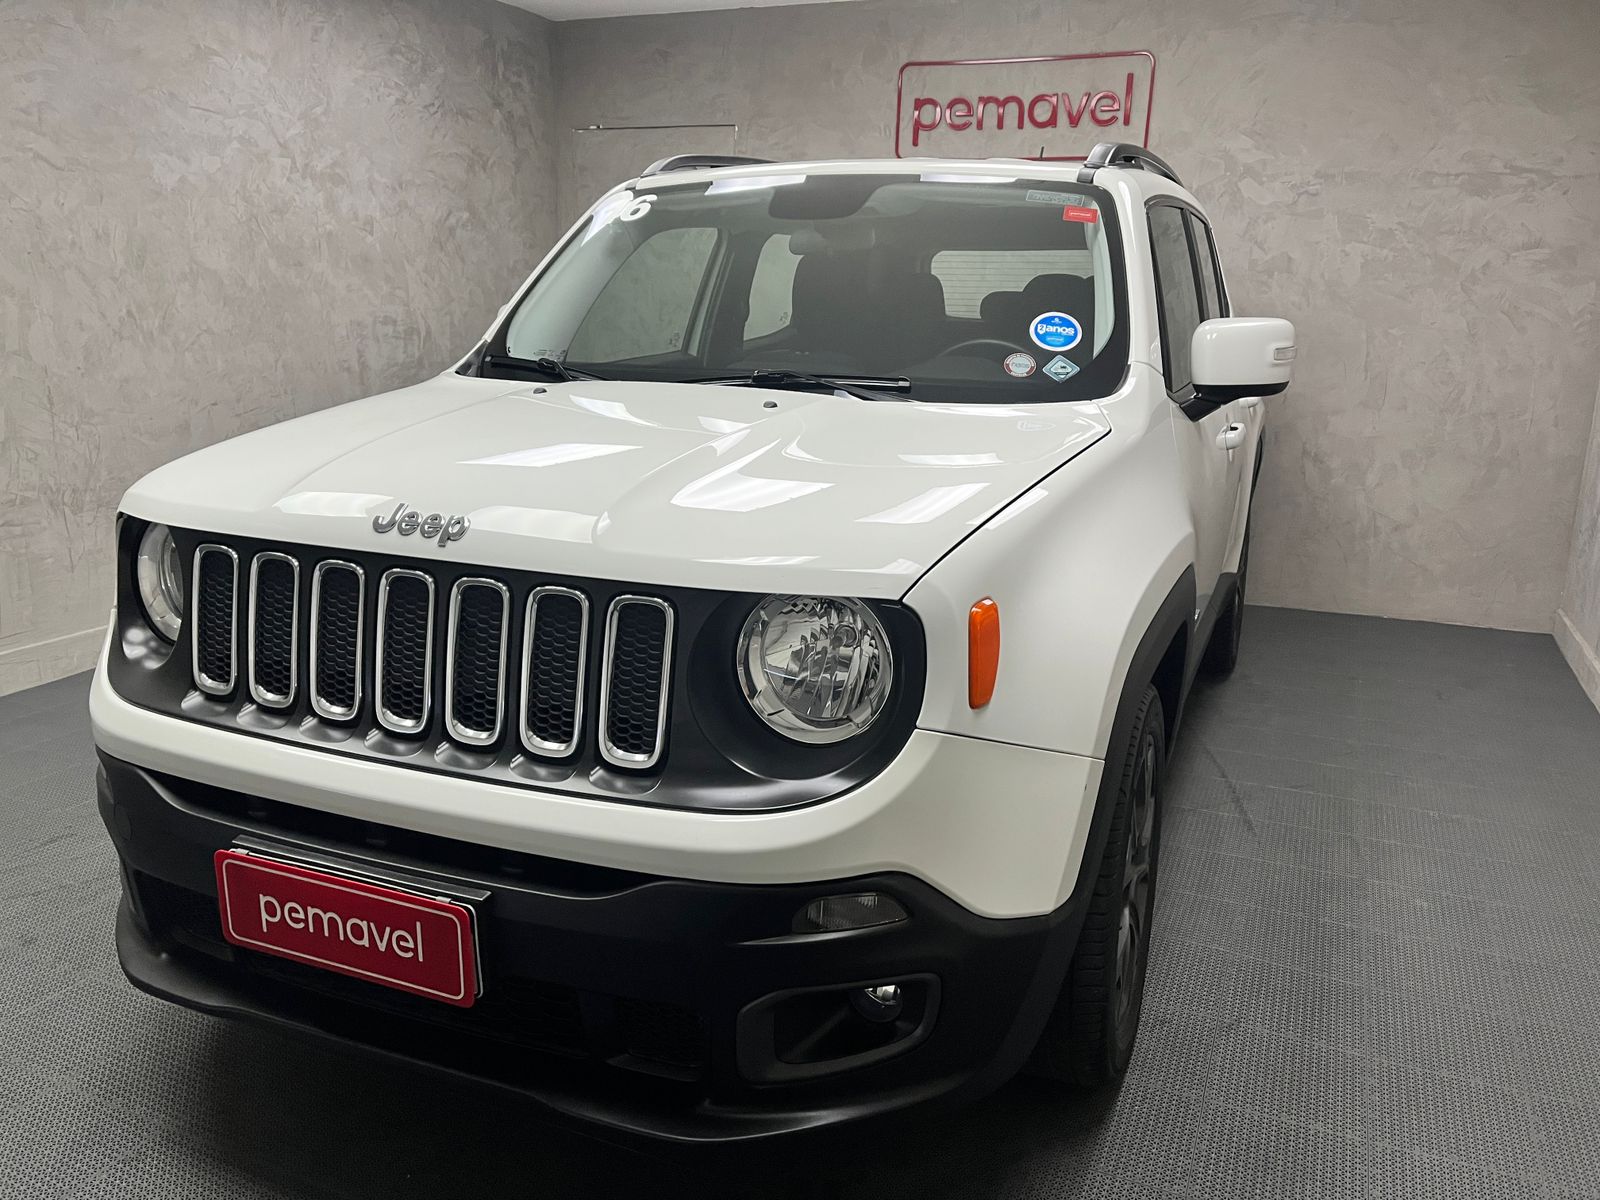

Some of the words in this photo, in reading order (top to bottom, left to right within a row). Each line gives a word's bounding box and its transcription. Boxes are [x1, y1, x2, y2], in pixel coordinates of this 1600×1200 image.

[912, 73, 1134, 147] pemavel
[372, 502, 471, 548] Jeep
[259, 893, 423, 963] pemavel
